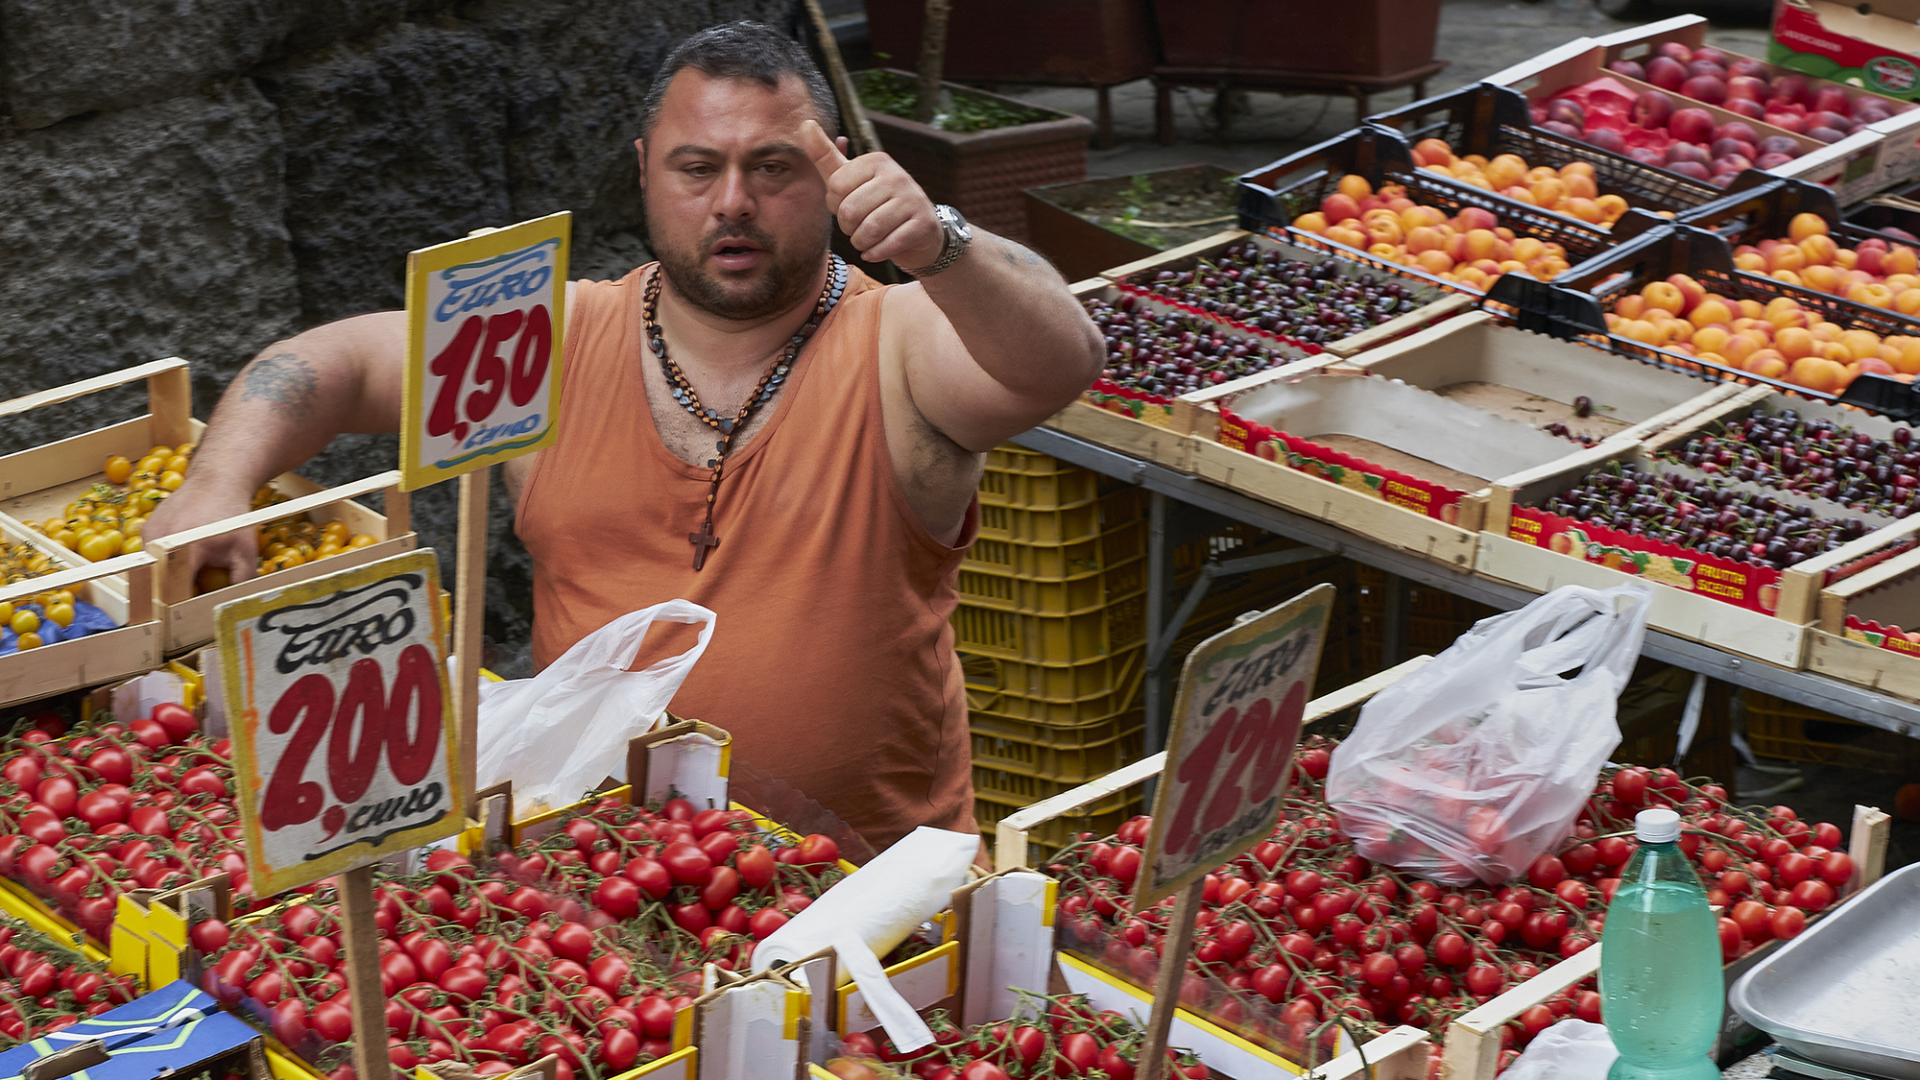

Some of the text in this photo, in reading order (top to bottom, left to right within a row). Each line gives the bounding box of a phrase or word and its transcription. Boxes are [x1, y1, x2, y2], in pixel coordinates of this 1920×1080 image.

[434, 249, 553, 323] EURO
[1386, 480, 1432, 503] FRUTTA
[1696, 563, 1747, 586] FRUTTA
[1696, 578, 1744, 600] SCELTA
[275, 587, 416, 674] EURO
[345, 781, 443, 834] CHILO
